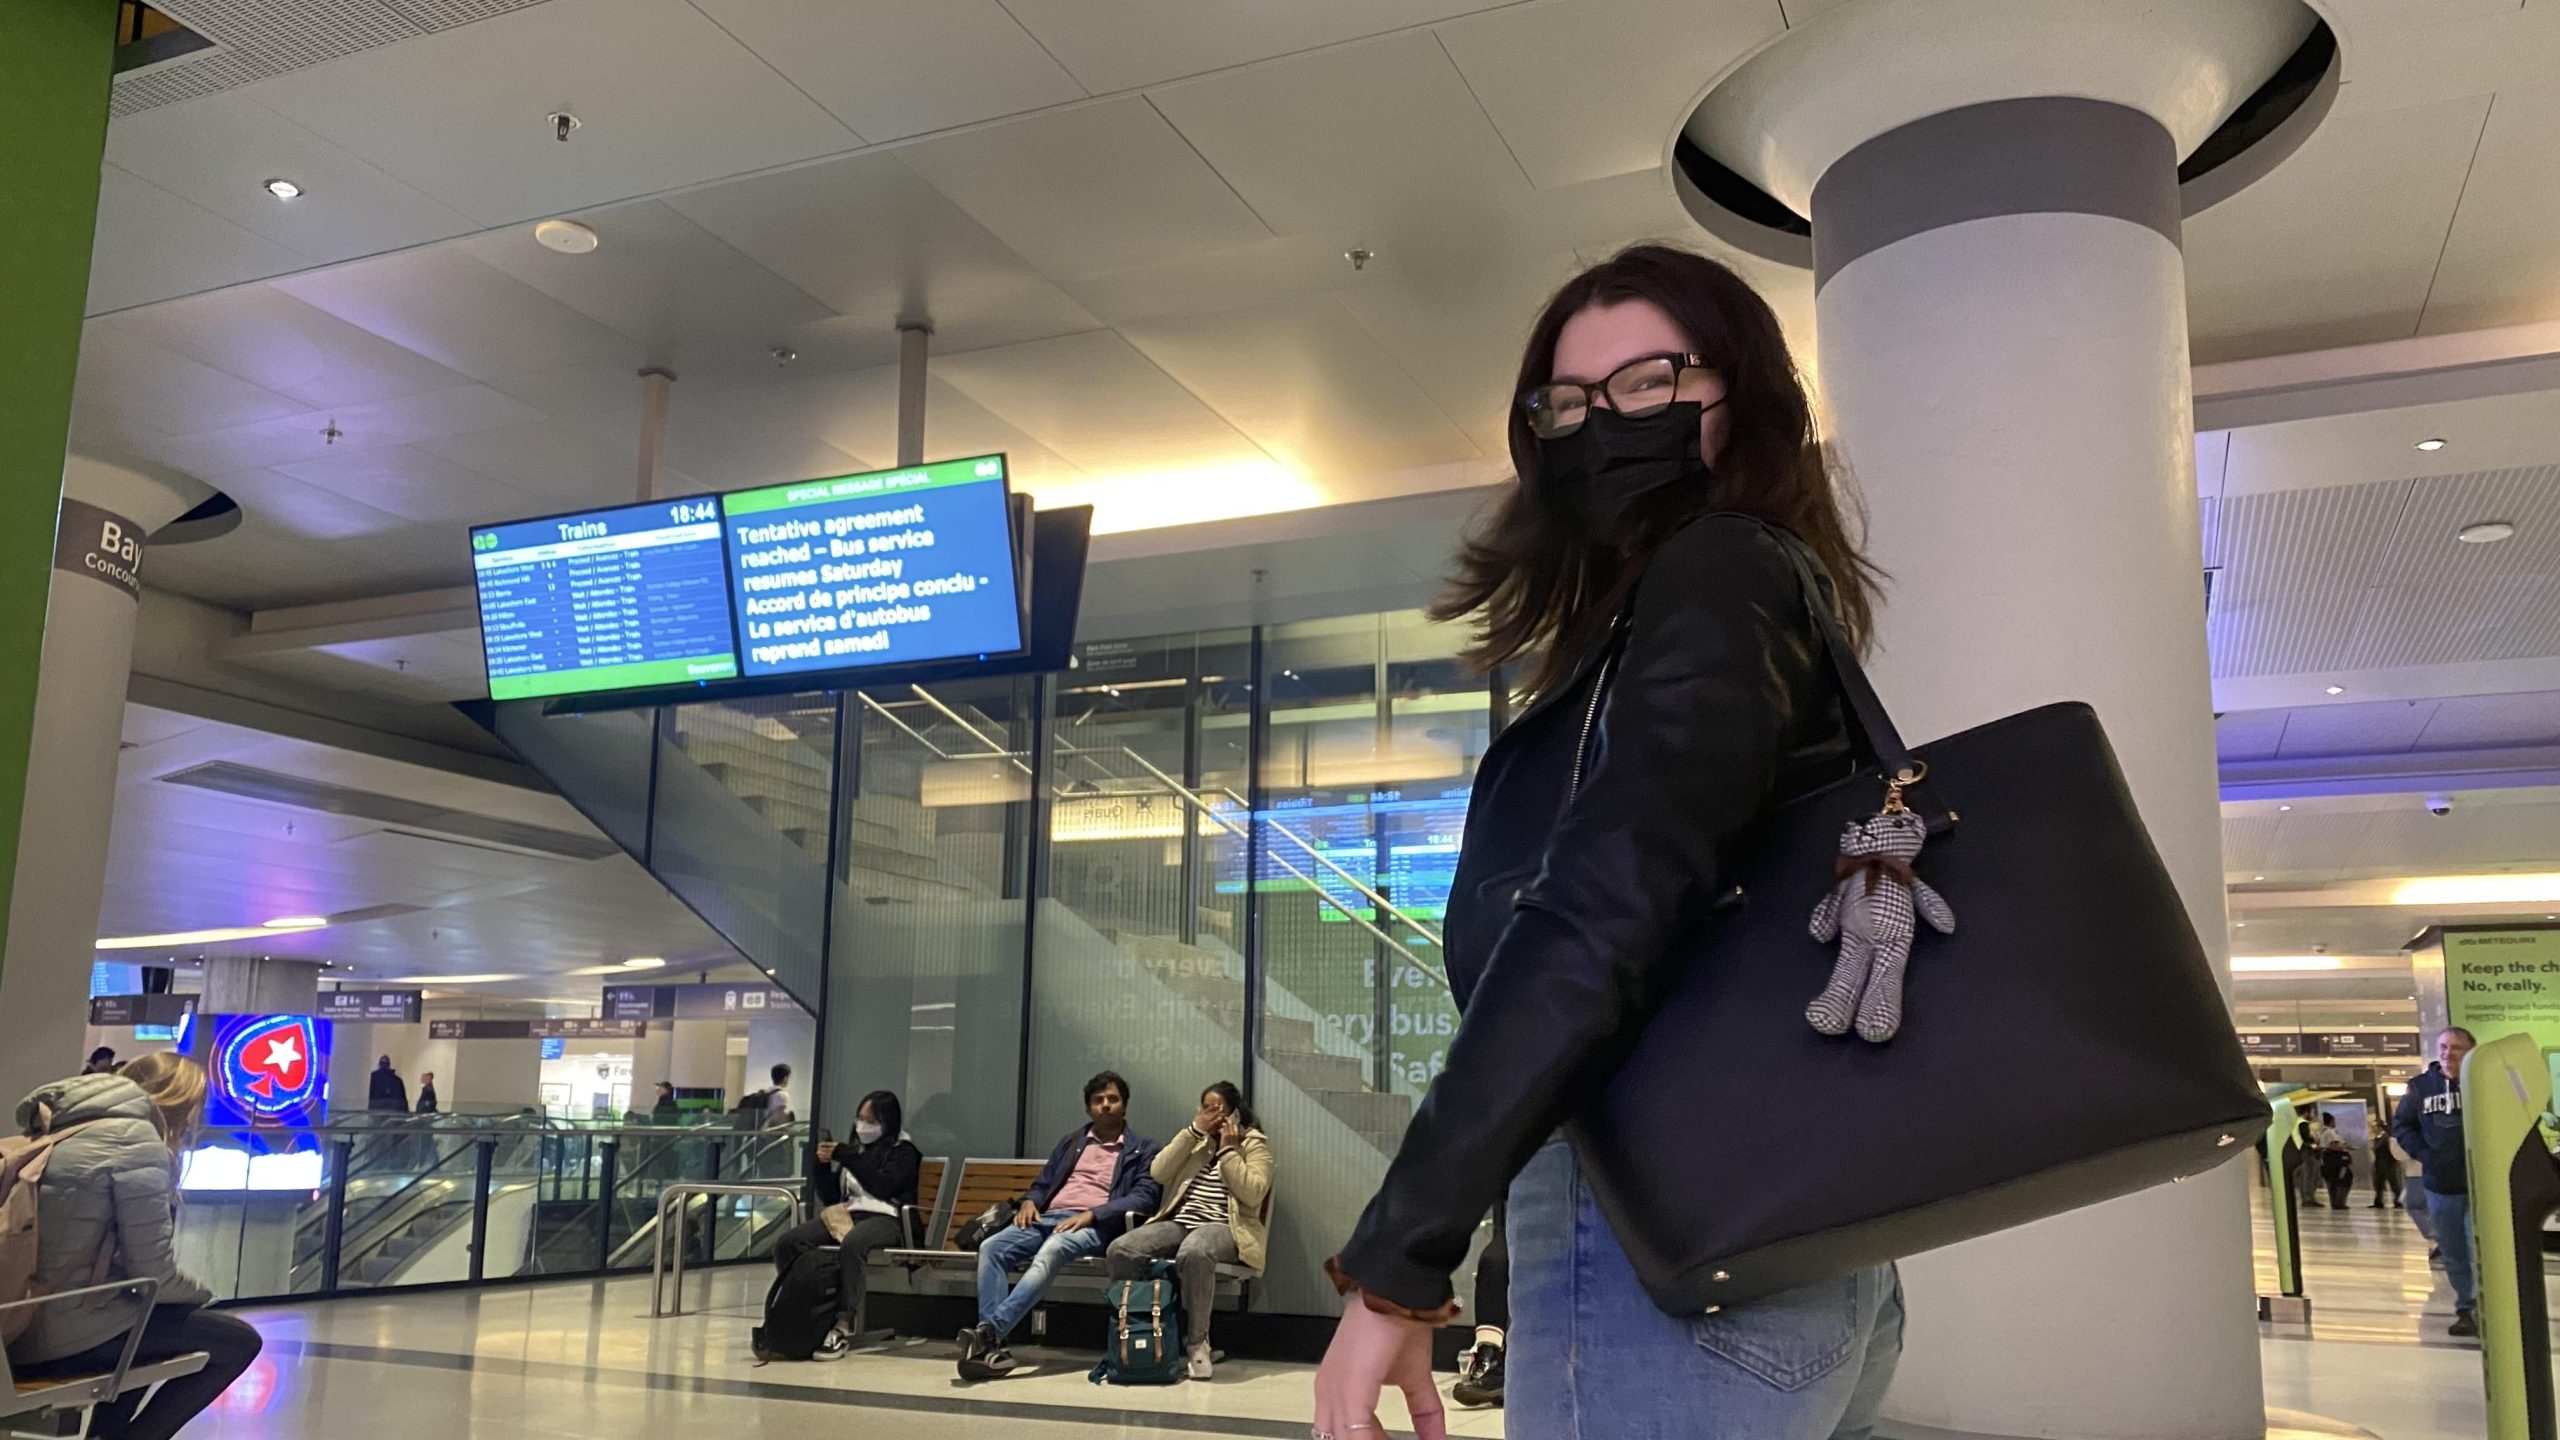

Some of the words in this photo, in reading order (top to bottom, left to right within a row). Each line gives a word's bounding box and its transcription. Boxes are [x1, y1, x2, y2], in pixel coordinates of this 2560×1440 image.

[787, 486, 830, 502] SPECIAL
[832, 478, 884, 497] MESSAGE
[670, 501, 716, 524] 18:44
[737, 519, 821, 545] Tentative
[825, 504, 925, 536] agreement
[101, 520, 143, 573] Bay
[558, 520, 608, 541] Trains
[740, 542, 811, 569] reached
[830, 535, 865, 558] Bus
[868, 529, 935, 552] service
[743, 567, 818, 592] resumes
[820, 558, 903, 584] Saturday
[746, 592, 806, 616] Accord
[809, 589, 832, 609] de
[835, 580, 911, 610] principe
[913, 572, 976, 597] conclu
[749, 620, 770, 639] Le
[773, 614, 836, 637] service
[839, 604, 931, 629] d'autobus
[751, 638, 820, 665] reprend
[824, 629, 890, 655] samedi
[2462, 962, 2504, 976] Keep
[2509, 961, 2535, 973] the
[2463, 980, 2492, 993] No,
[2496, 979, 2546, 994] really.
